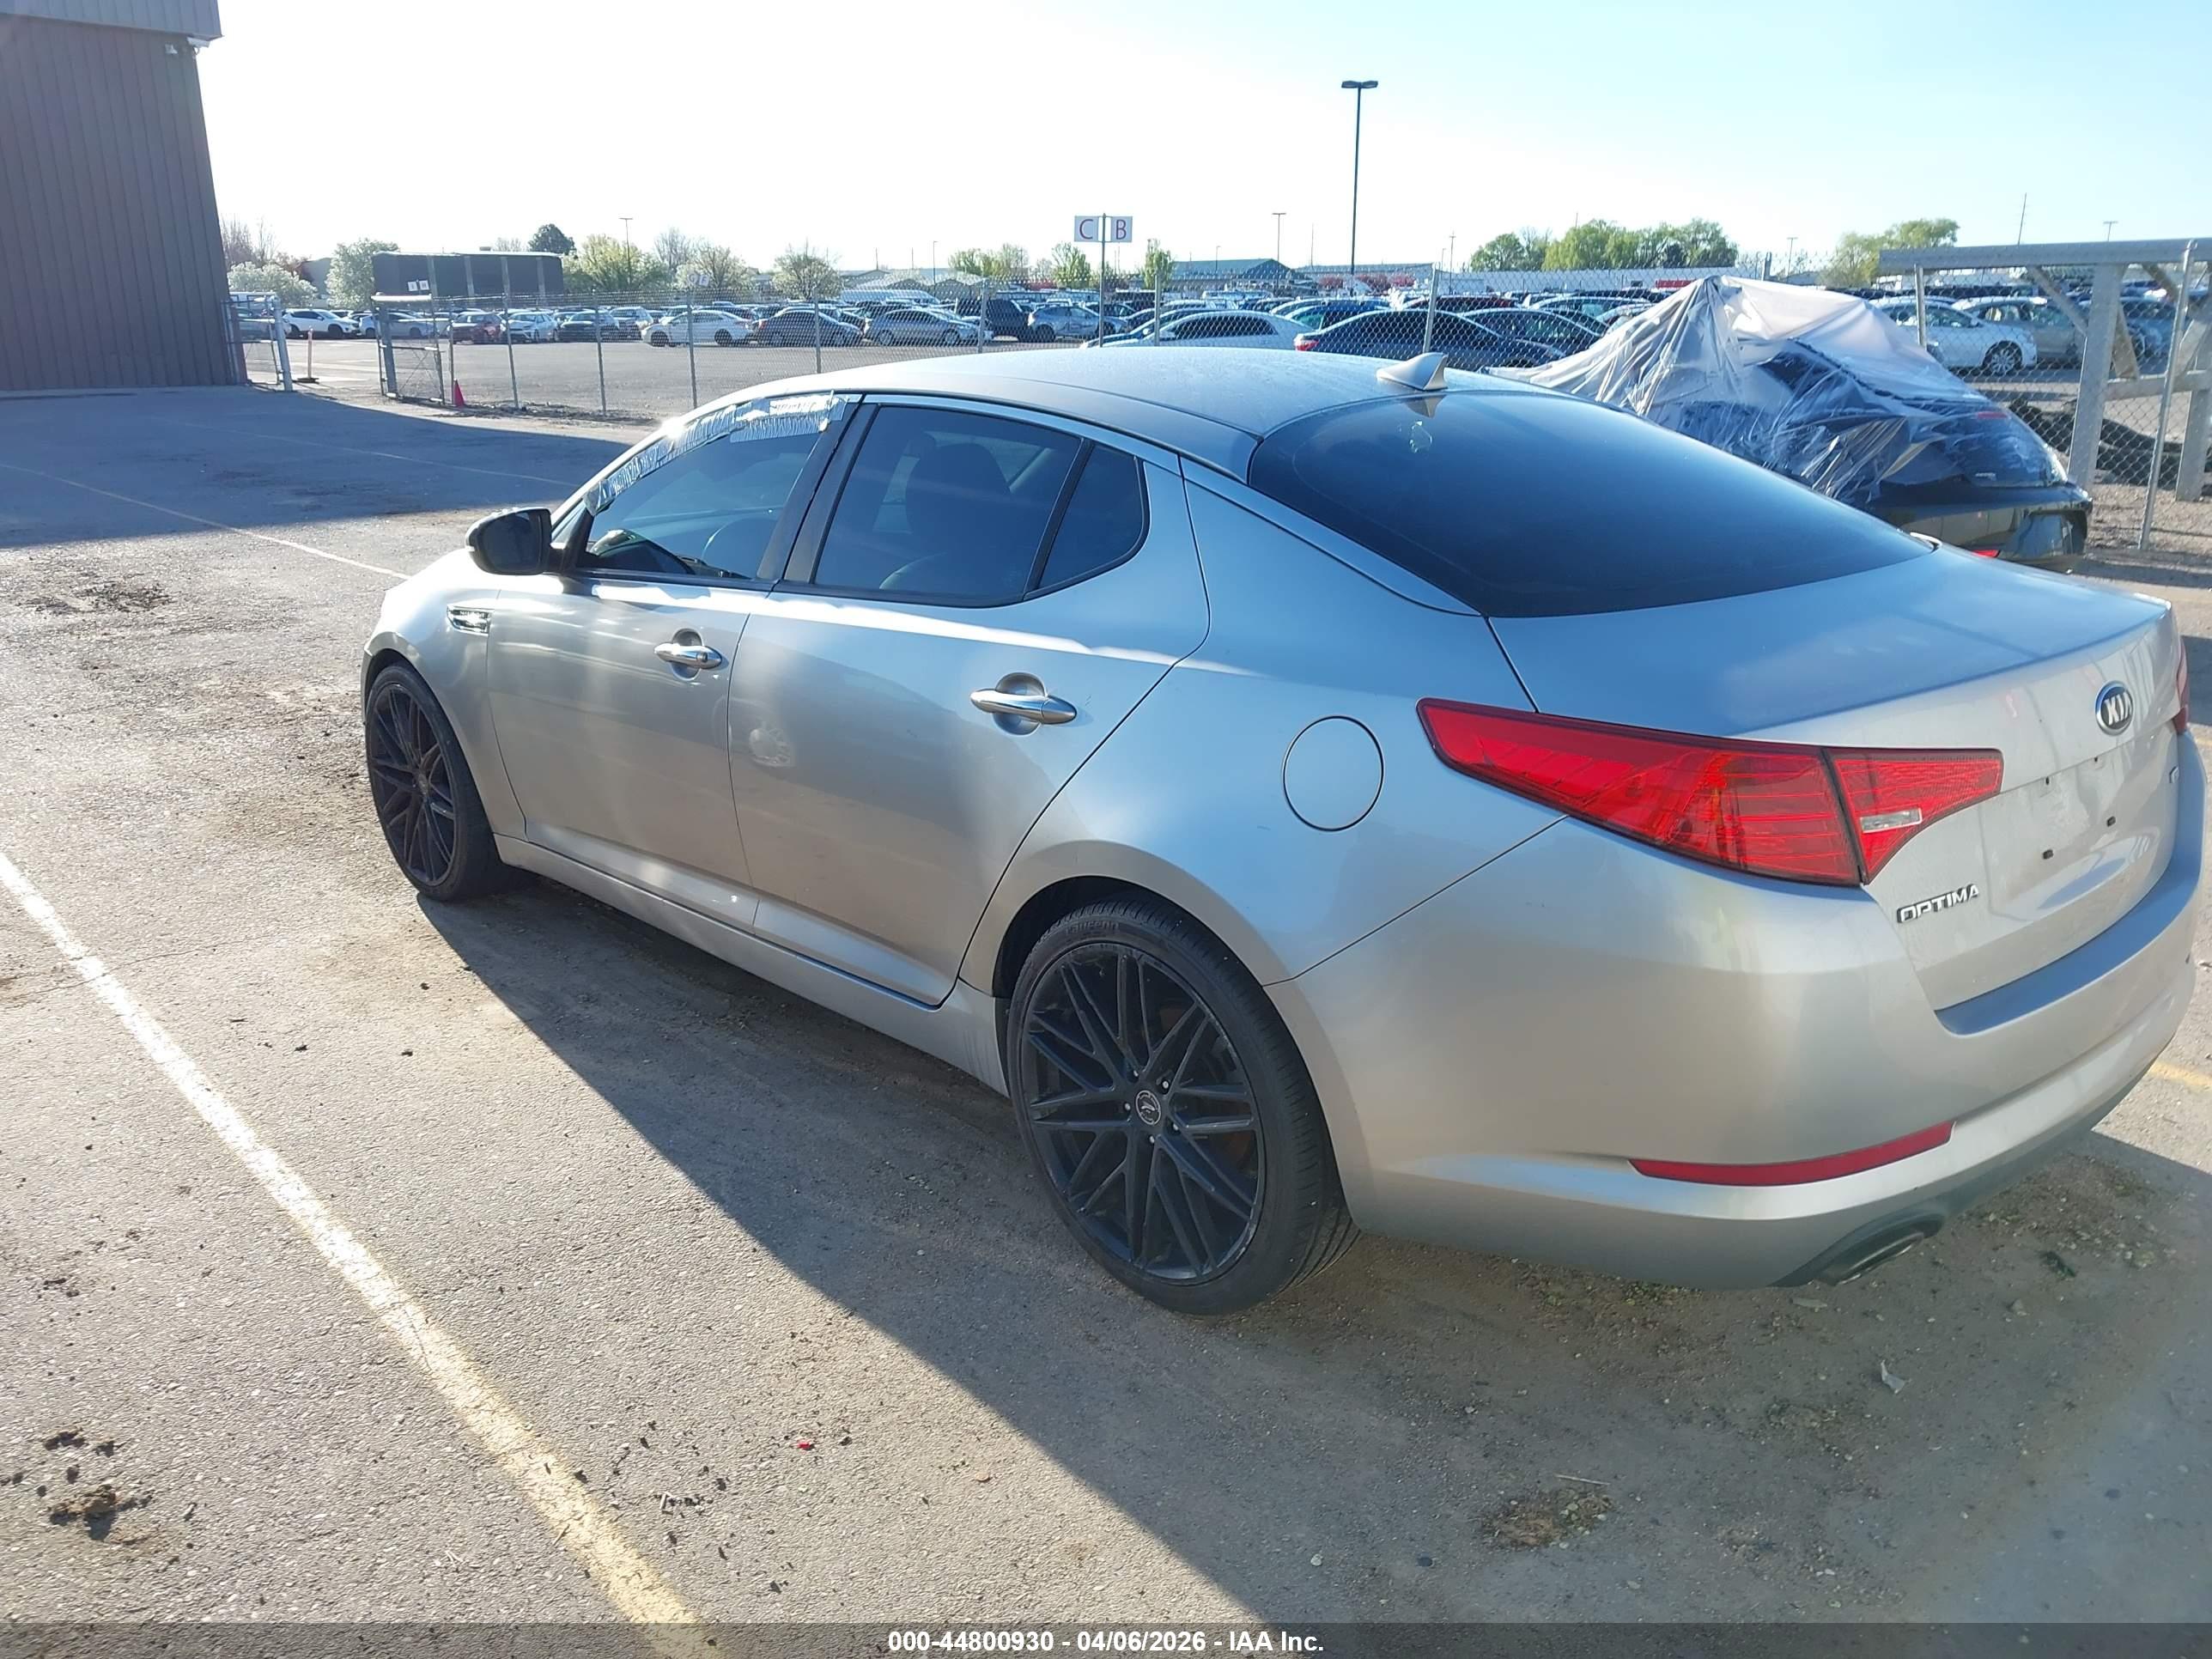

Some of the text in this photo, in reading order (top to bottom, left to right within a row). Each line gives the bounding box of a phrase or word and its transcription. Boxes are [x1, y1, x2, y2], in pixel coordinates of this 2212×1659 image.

[1079, 218, 1094, 240] C
[1115, 218, 1127, 240] B
[2104, 690, 2133, 726] KIA
[1897, 884, 1980, 923] OPTIMA
